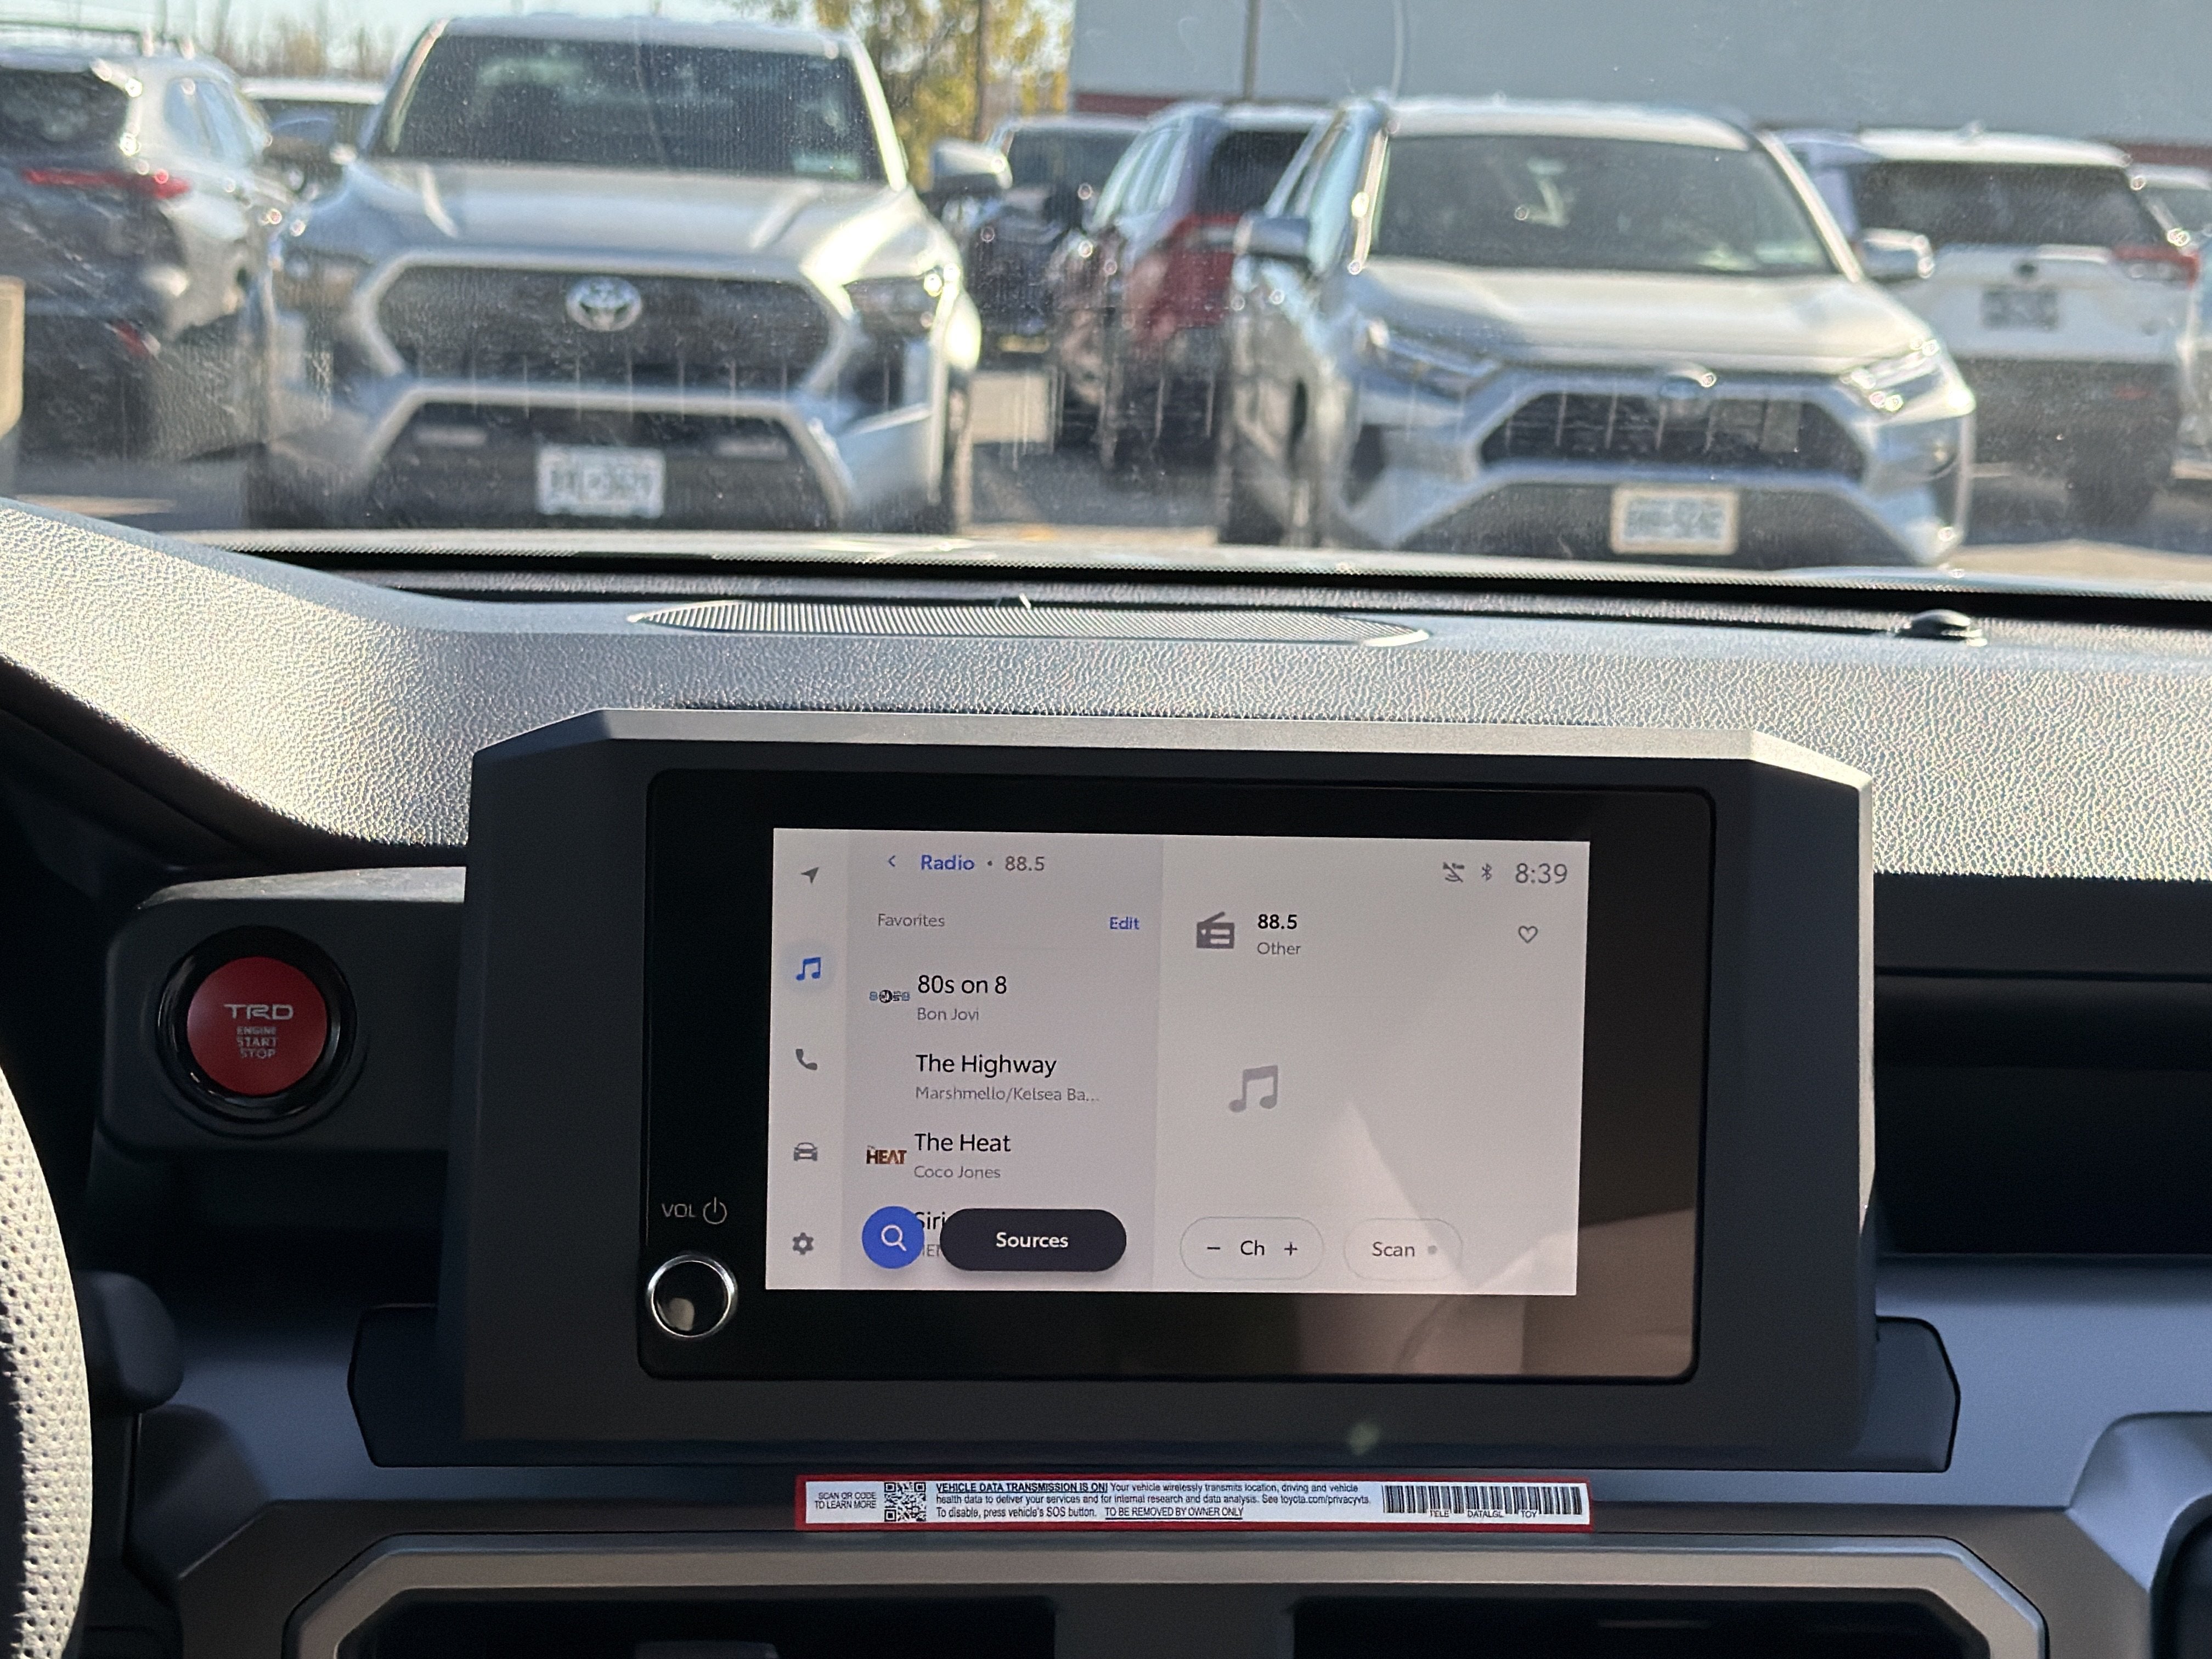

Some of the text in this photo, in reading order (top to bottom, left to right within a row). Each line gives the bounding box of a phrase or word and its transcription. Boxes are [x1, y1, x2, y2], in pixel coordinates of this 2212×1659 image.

[921, 855, 1046, 872] Radio 88.5
[1515, 863, 1568, 884] 8:39
[878, 914, 1139, 930] Favorites Edit
[1257, 914, 1298, 930] 88.5
[1257, 942, 1301, 956] Other
[918, 975, 1008, 995] 80s on 8
[223, 1003, 294, 1020] TRD
[917, 1007, 980, 1022] Bon Jovi
[236, 1026, 277, 1035] ENGINE
[236, 1036, 277, 1047] START
[239, 1048, 276, 1059] STOP
[916, 1054, 1057, 1077] The Highway
[915, 1086, 1100, 1102] Marshmello/Kelsea Ba...
[914, 1132, 1011, 1153] The Heat
[866, 1150, 907, 1165] HEAT
[914, 1165, 1001, 1180] Coco Jones
[661, 1203, 696, 1217] VOL
[996, 1232, 1069, 1248] Sources
[1240, 1240, 1265, 1256] Ch
[1372, 1242, 1415, 1257] Scan
[936, 1482, 976, 1492] VEHICLE
[979, 1482, 1004, 1492] DATA
[1006, 1482, 1077, 1492] TRANSMISSION
[1080, 1482, 1088, 1492] IS
[1110, 1482, 1129, 1492] Your
[1132, 1482, 1160, 1492] vehicle
[1163, 1482, 1203, 1493] wirelessly
[1205, 1483, 1242, 1492] transmits
[1245, 1483, 1279, 1493] location,
[1282, 1483, 1308, 1493] driving
[1311, 1483, 1327, 1492] and
[1329, 1483, 1358, 1492] vehicle
[815, 1500, 877, 1509] TO LEARN MORE
[936, 1494, 962, 1504] health
[964, 1494, 983, 1504] data
[985, 1495, 994, 1504] to
[996, 1494, 1023, 1504] deliver
[1025, 1496, 1044, 1506] your
[1046, 1495, 1081, 1504] services
[1082, 1494, 1098, 1503] and
[1101, 1494, 1111, 1503] for
[1114, 1494, 1145, 1503] internal
[1147, 1494, 1183, 1503] research
[1186, 1494, 1200, 1503] and
[1203, 1494, 1221, 1503] data
[1262, 1494, 1278, 1503] See
[936, 1506, 1244, 1519] To disable, press vehicle's SOS button. TO BE REMOVED BY OWNER ONLY
[1430, 1509, 1450, 1517] TELE
[1521, 1509, 1537, 1518] TOY
